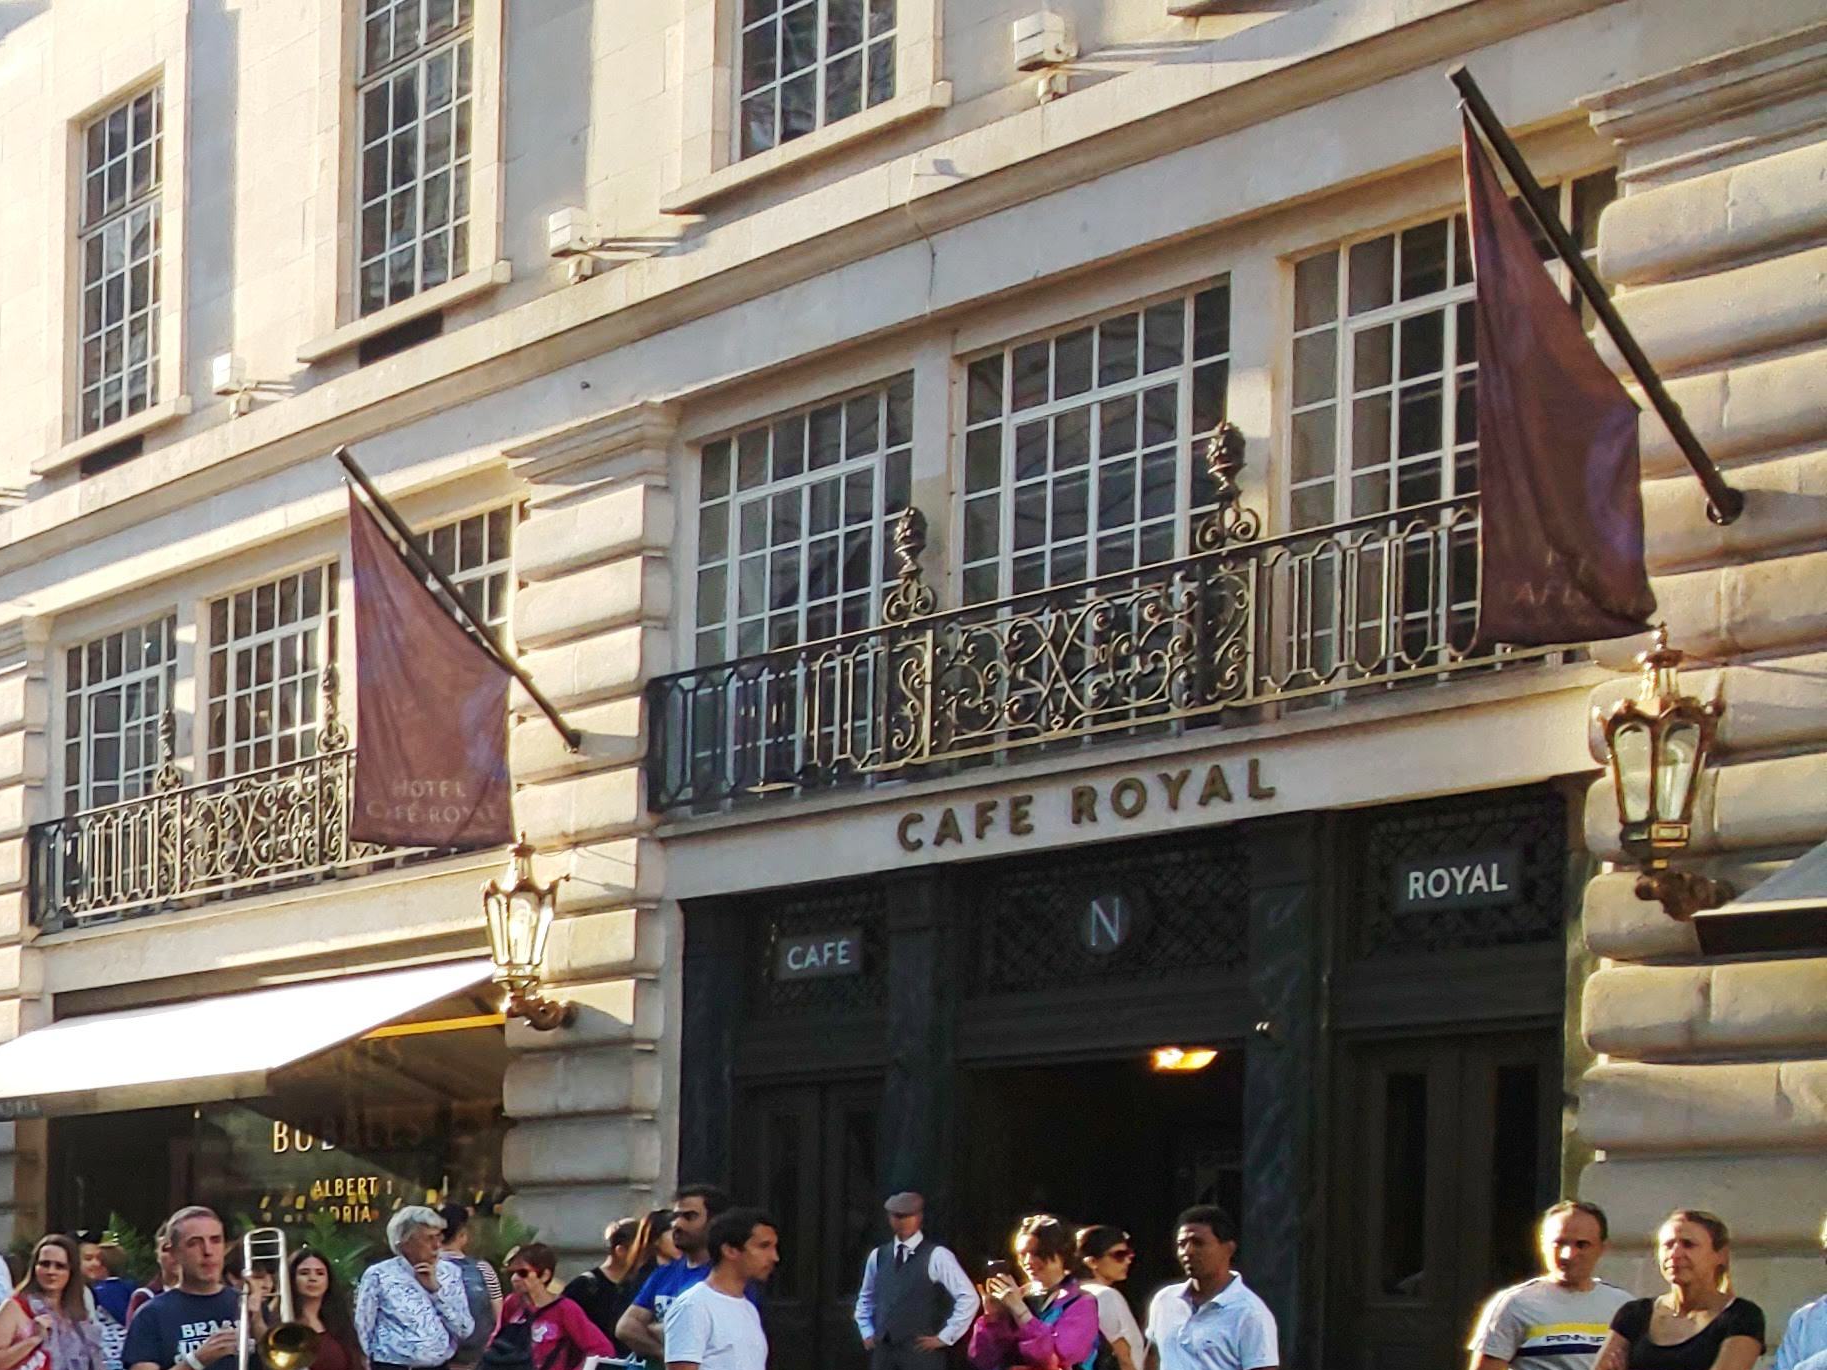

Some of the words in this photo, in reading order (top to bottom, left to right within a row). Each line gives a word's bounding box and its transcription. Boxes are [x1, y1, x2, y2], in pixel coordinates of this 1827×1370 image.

[897, 794, 1034, 852] CAFE
[1071, 758, 1276, 825] ROYAL
[1408, 863, 1509, 900] ROYAL
[1090, 898, 1120, 946] N
[313, 1176, 378, 1197] ALBERT
